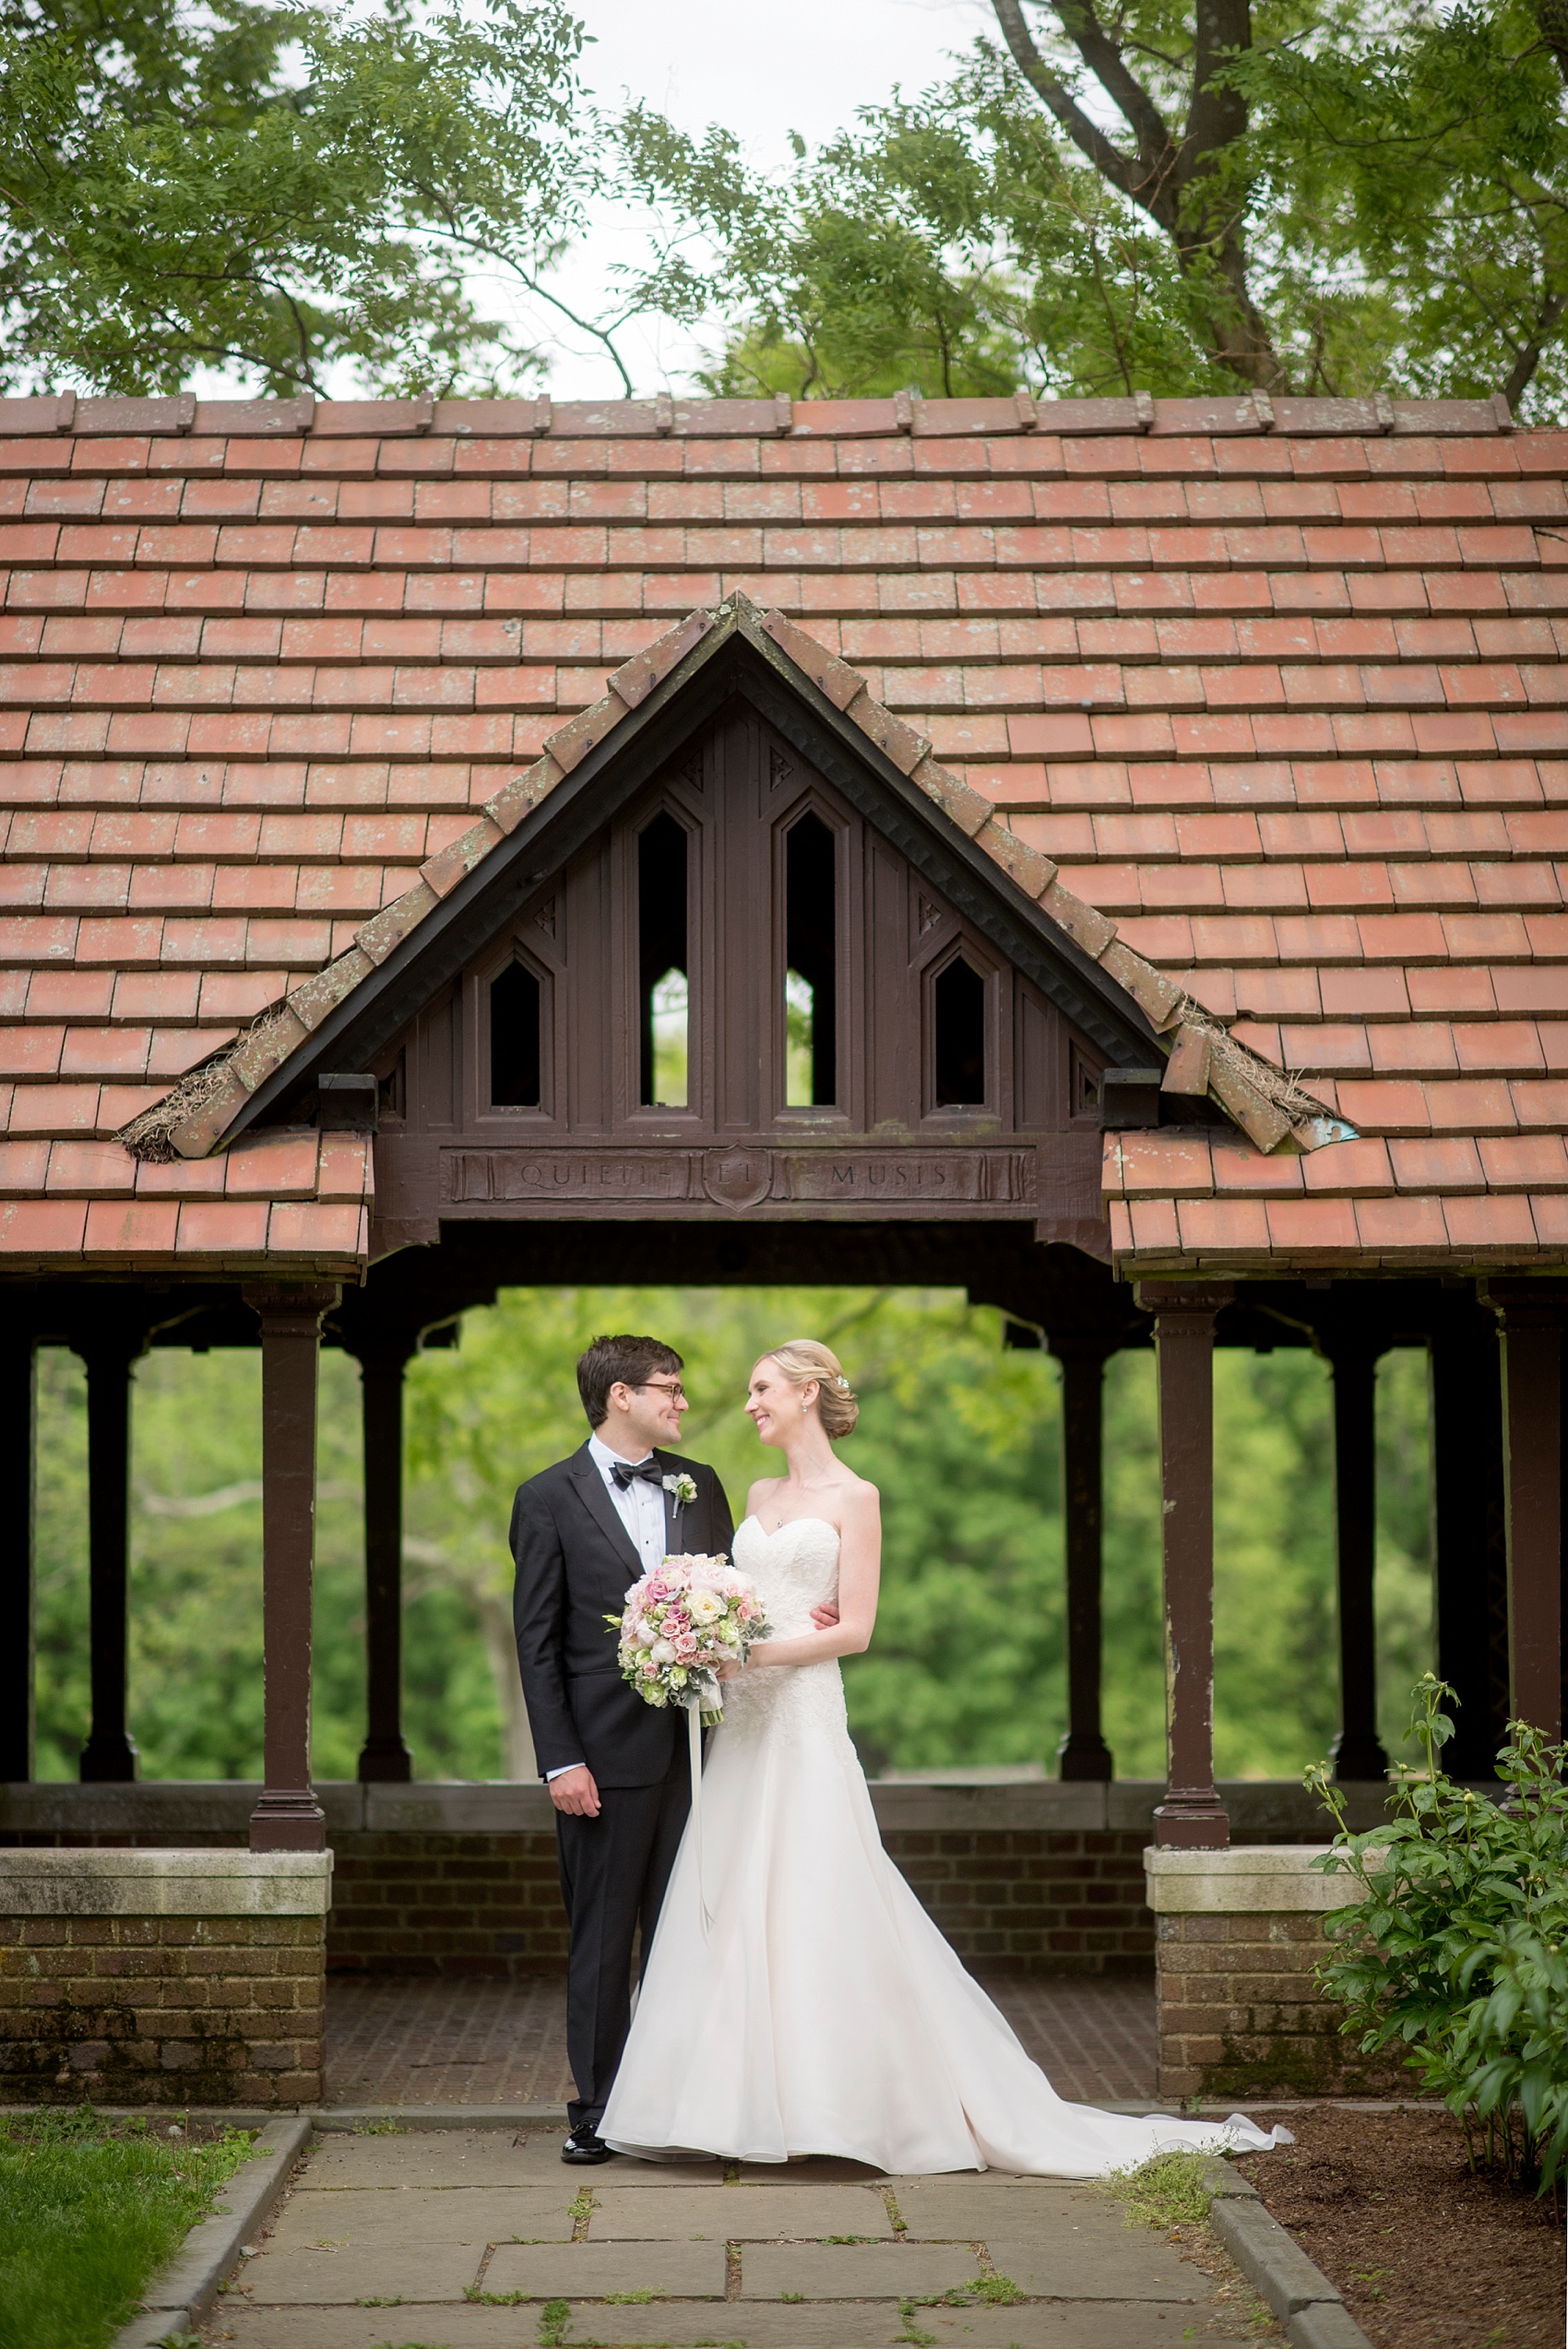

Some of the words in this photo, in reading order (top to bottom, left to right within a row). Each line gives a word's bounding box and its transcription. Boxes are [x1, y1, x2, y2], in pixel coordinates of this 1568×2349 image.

[521, 1165, 646, 1190] QUIETI
[719, 1164, 756, 1184] ET
[831, 1165, 945, 1185] MUSIS
